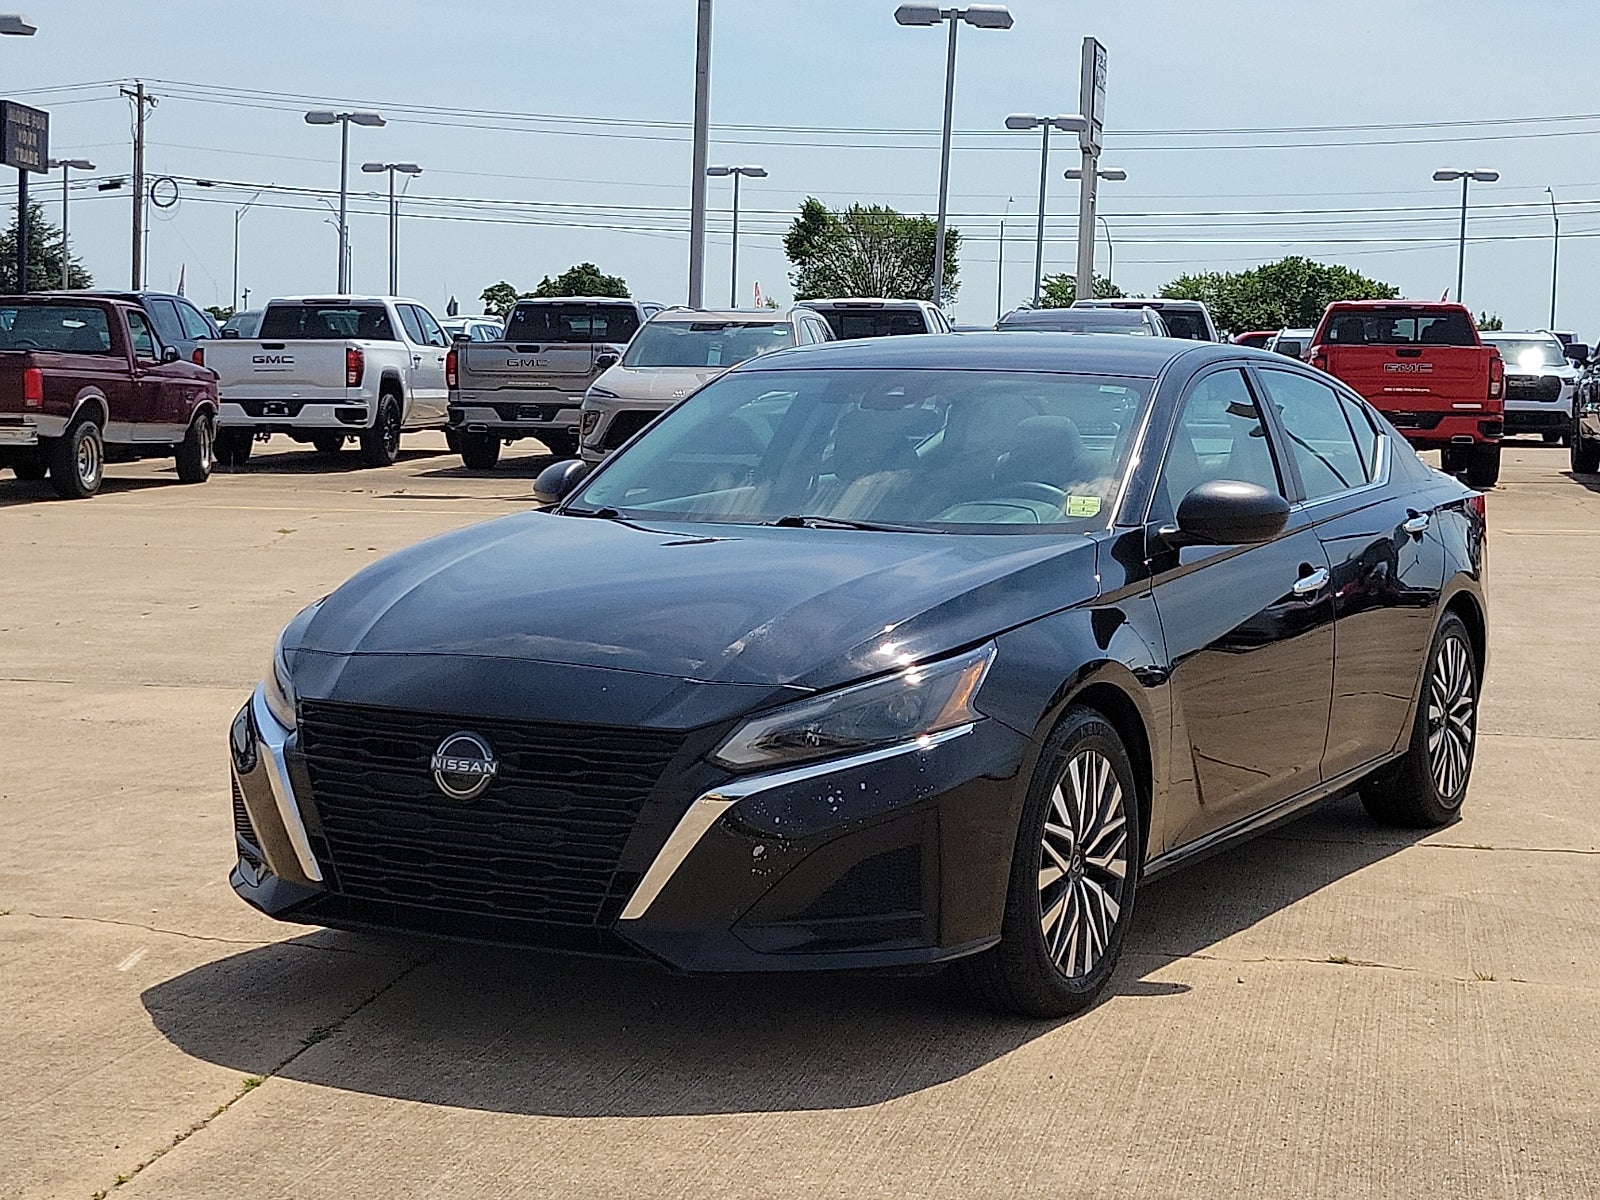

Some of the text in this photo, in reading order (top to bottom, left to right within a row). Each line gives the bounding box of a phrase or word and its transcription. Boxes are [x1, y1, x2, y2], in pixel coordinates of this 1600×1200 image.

[252, 355, 295, 364] GMC
[506, 358, 550, 367] GMC
[1383, 362, 1433, 373] GMC
[430, 754, 498, 774] NISSAN
